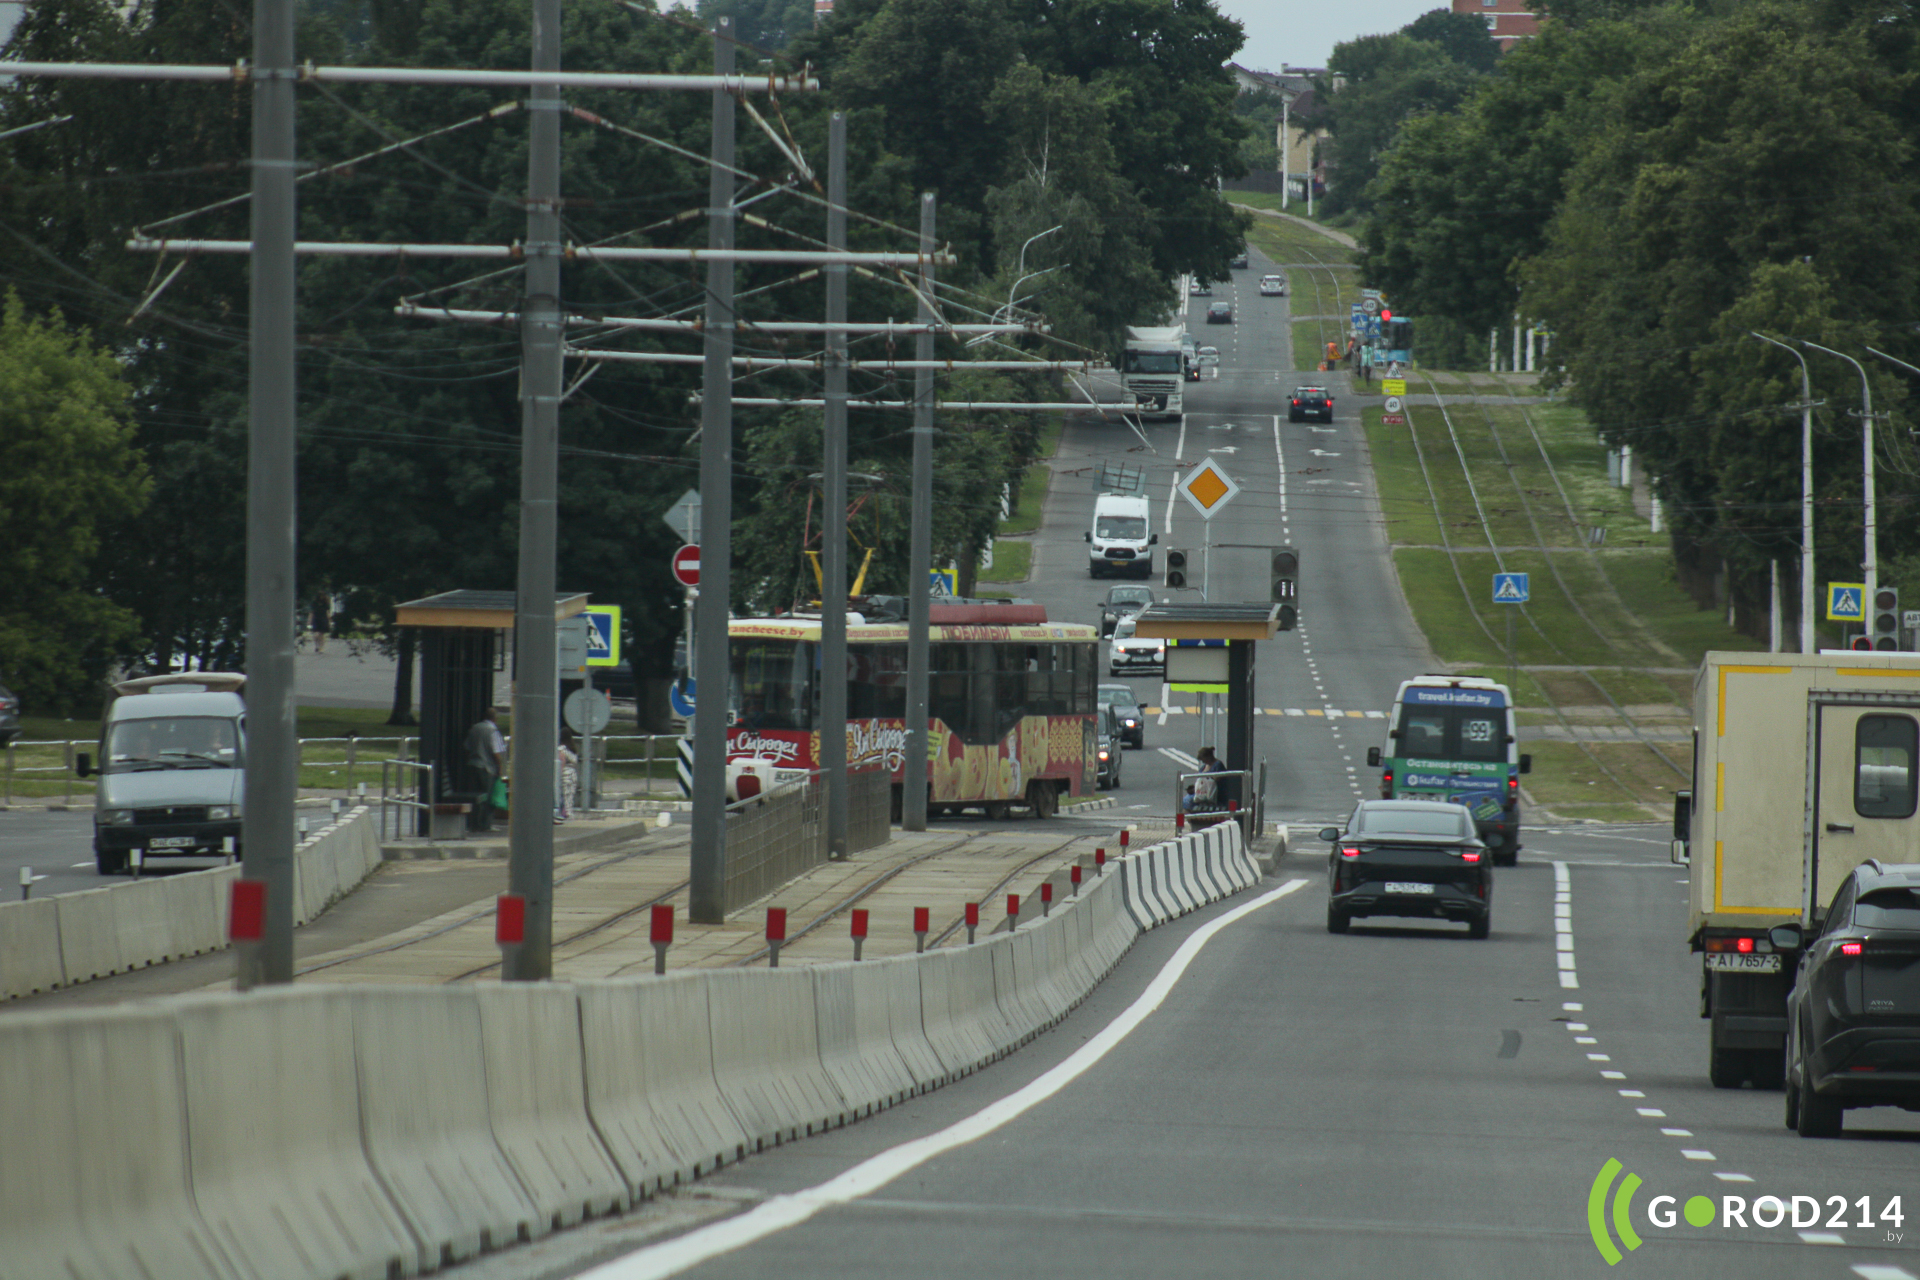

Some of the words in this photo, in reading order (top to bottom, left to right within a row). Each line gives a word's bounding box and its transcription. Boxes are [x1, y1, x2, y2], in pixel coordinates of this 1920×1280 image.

[1418, 692, 1491, 705] travel.kufar.by
[1471, 722, 1487, 739] 99
[1420, 776, 1446, 786] kufar
[1718, 954, 1734, 967] AI
[1739, 954, 1780, 969] 7657-2
